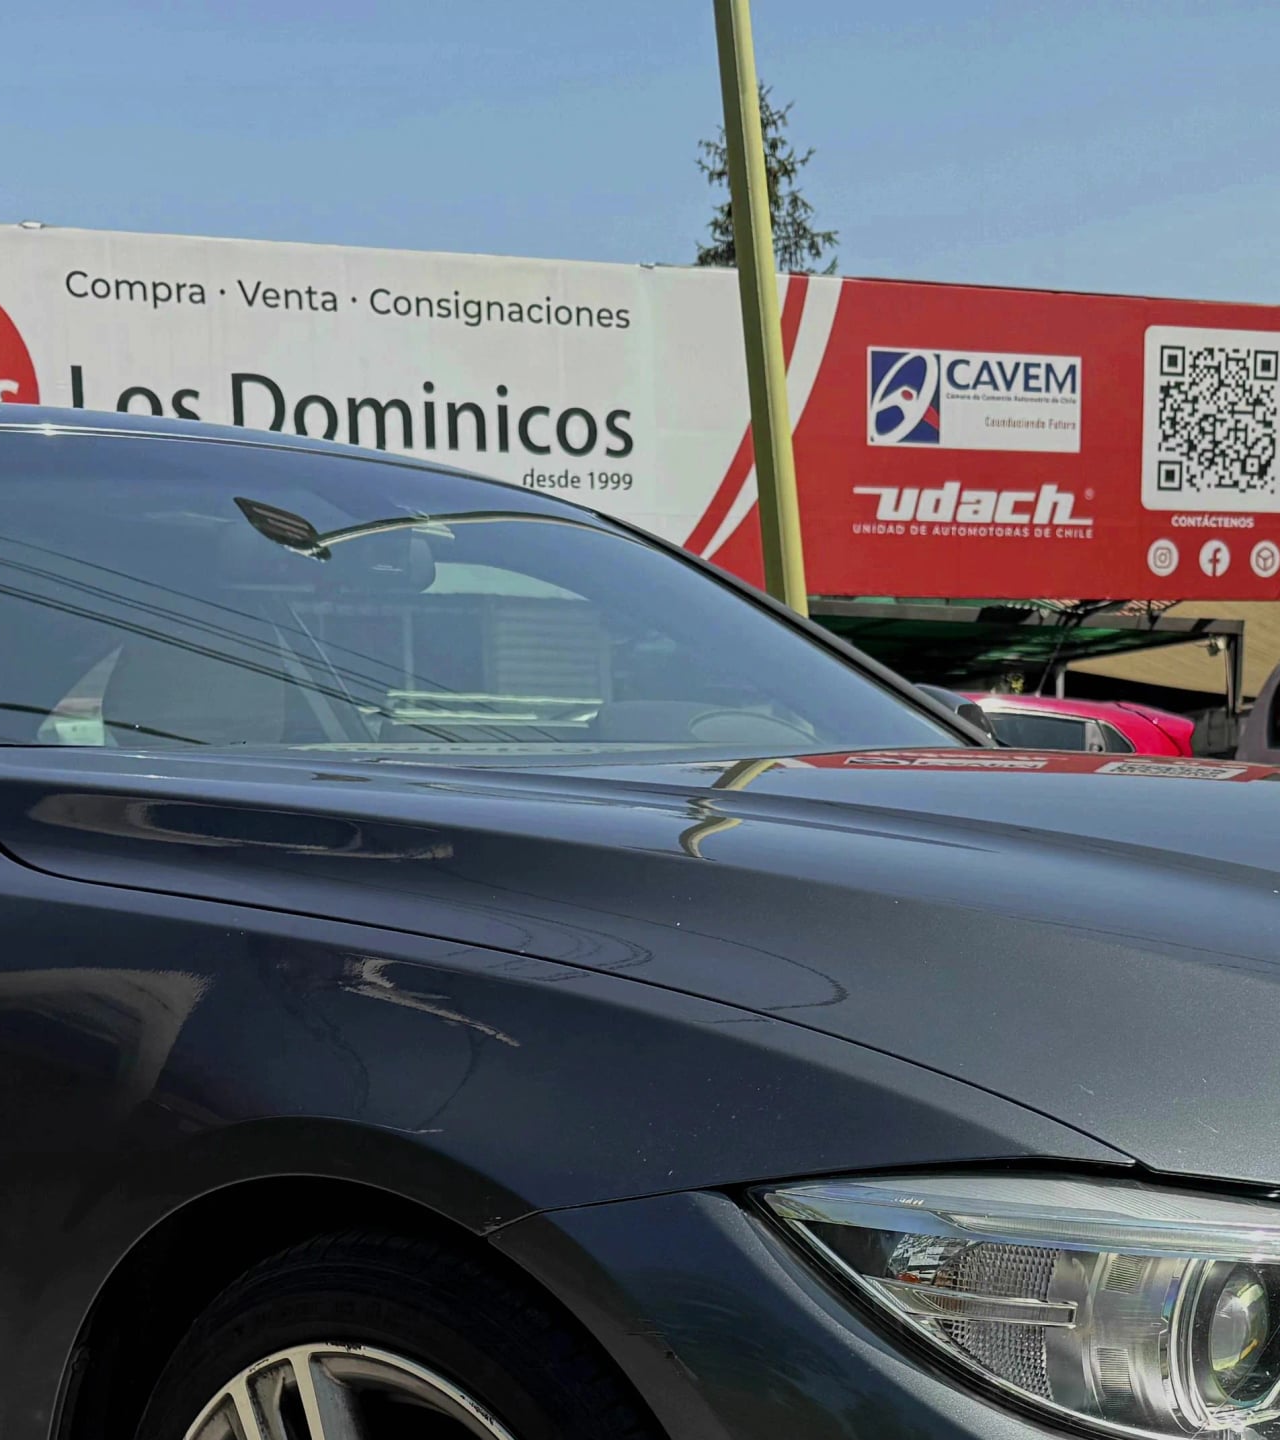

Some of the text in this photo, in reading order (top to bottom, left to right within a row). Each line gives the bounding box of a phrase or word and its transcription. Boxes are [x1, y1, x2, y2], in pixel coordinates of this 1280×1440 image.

[65, 270, 206, 308] Compra
[237, 279, 338, 312] Venta
[369, 288, 631, 329] Consignaciones
[946, 358, 1077, 394] CAVEM
[231, 372, 634, 458] Dominicos
[523, 467, 634, 491] desde 1999
[852, 480, 1094, 526] udach
[1171, 513, 1255, 529] CONTÁCTENOS
[852, 522, 1093, 539] UNIDAD DE AUTOMOTORAS DE CHILE
